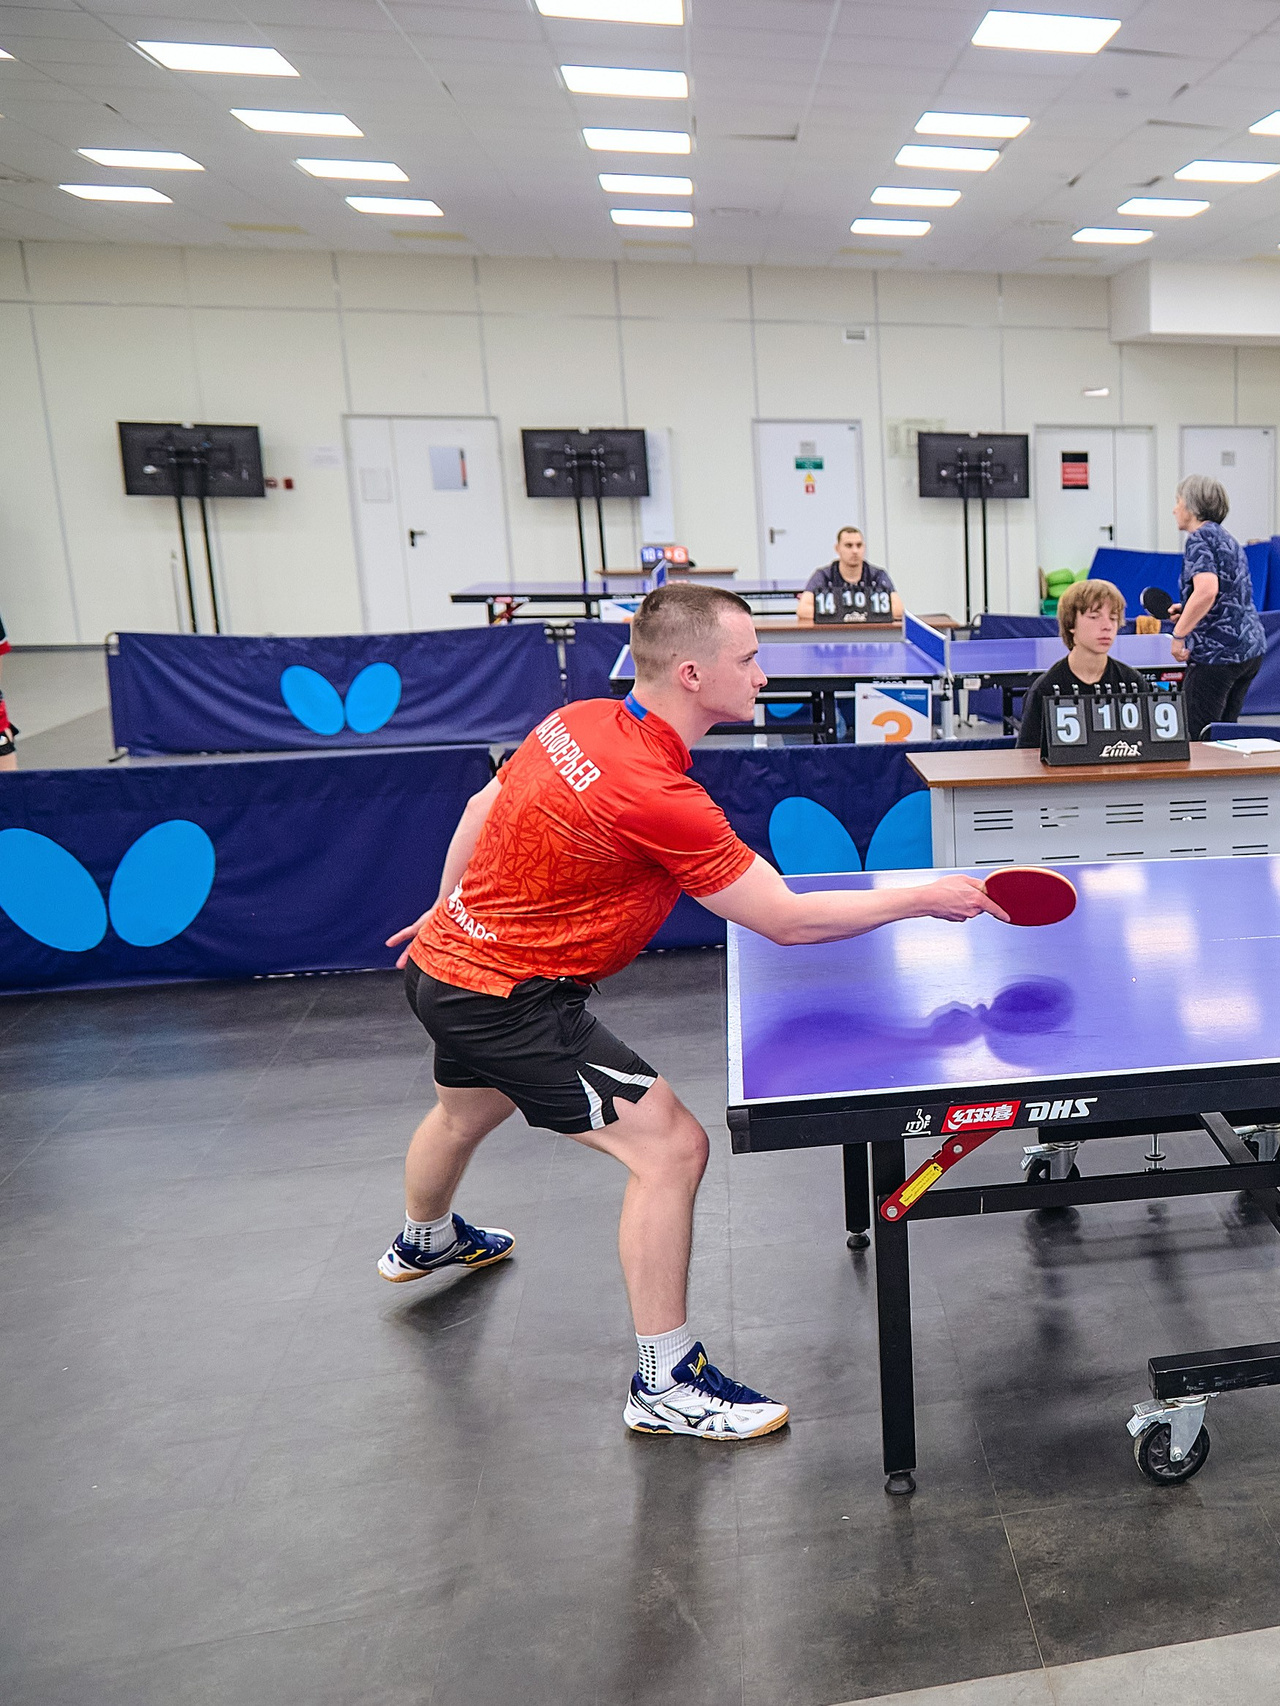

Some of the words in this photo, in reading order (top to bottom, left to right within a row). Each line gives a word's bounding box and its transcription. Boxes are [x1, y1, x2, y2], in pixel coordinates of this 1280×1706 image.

[816, 592, 836, 614] 14
[870, 592, 890, 613] 13
[1056, 706, 1081, 743] 5
[1154, 703, 1179, 739] 9
[947, 1103, 1014, 1131] 红双喜
[1024, 1097, 1099, 1122] DHS
